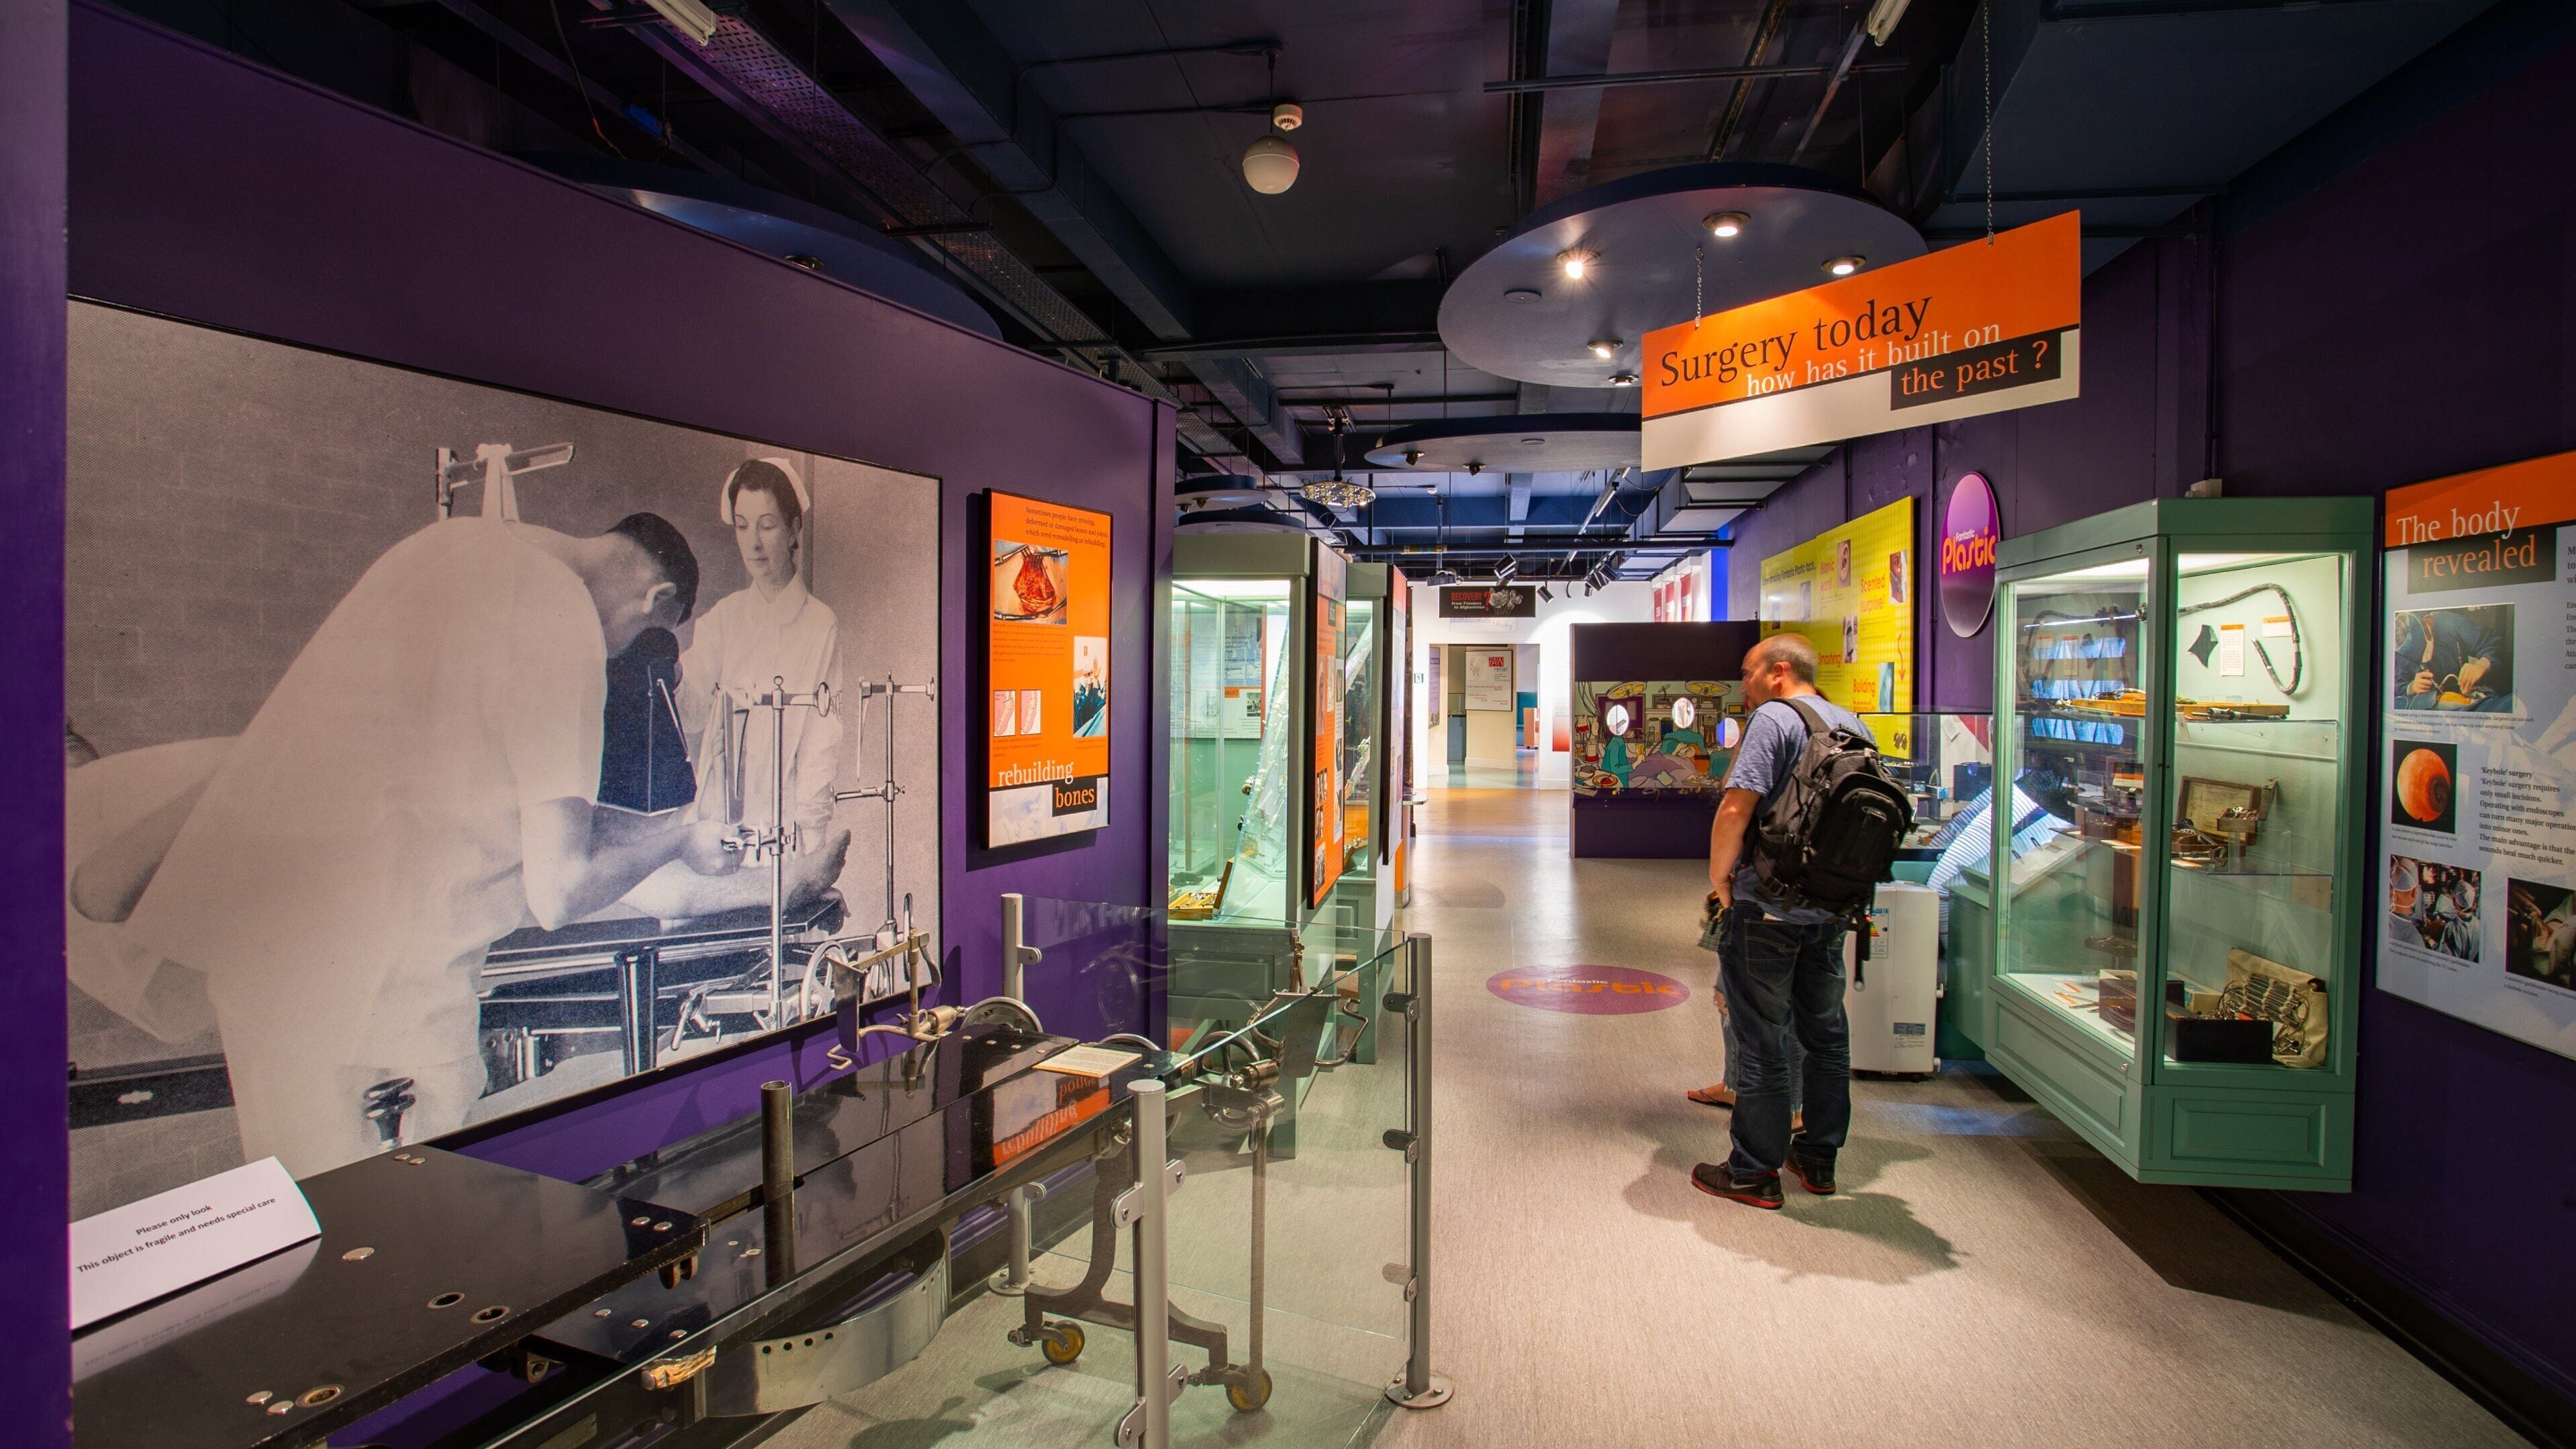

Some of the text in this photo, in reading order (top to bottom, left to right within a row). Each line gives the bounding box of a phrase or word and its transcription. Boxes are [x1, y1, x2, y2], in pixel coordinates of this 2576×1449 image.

[1660, 296, 1932, 386] Surgery today
[1746, 324, 2000, 397] how has it built on
[1900, 341, 2048, 395] the past ?
[1026, 506, 1051, 517] Sometimes
[1052, 513, 1067, 521] people
[2396, 500, 2520, 545] The body
[1026, 517, 1048, 527] deformed
[1054, 523, 1074, 532] damaged
[1026, 529, 1040, 537] which
[1955, 529, 1975, 542] Fantastic
[1943, 526, 1996, 574] Plastic
[2422, 534, 2537, 578] revealed
[1861, 574, 1885, 593] Scented
[1451, 592, 1483, 600] RECOVERY
[1861, 594, 1884, 614] surprise!
[1818, 652, 1842, 667] Smashing!
[998, 760, 1073, 784] rebuilding
[2509, 770, 2532, 780] surgery
[2480, 790, 2493, 798] only
[2512, 793, 2542, 802] incisions.
[2508, 782, 2532, 790] surgery
[2533, 784, 2560, 792] requires
[1055, 788, 1095, 808] bones
[2480, 800, 2510, 811] Operating
[2526, 807, 2564, 817] endoscopes
[2506, 816, 2523, 824] many
[2525, 818, 2544, 826] major
[2479, 846, 2563, 865] wounds heal much quicker.
[2509, 839, 2540, 850] advantage
[2549, 845, 2563, 853] that
[1500, 977, 1680, 996] Plastic
[136, 1205, 213, 1236] Please only look
[76, 1262, 100, 1273] This
[102, 1248, 134, 1265] object
[145, 1234, 176, 1248] fragile
[178, 1226, 196, 1237] and
[198, 1217, 225, 1230] needs
[226, 1204, 257, 1219] special
[258, 1197, 276, 1208] care
